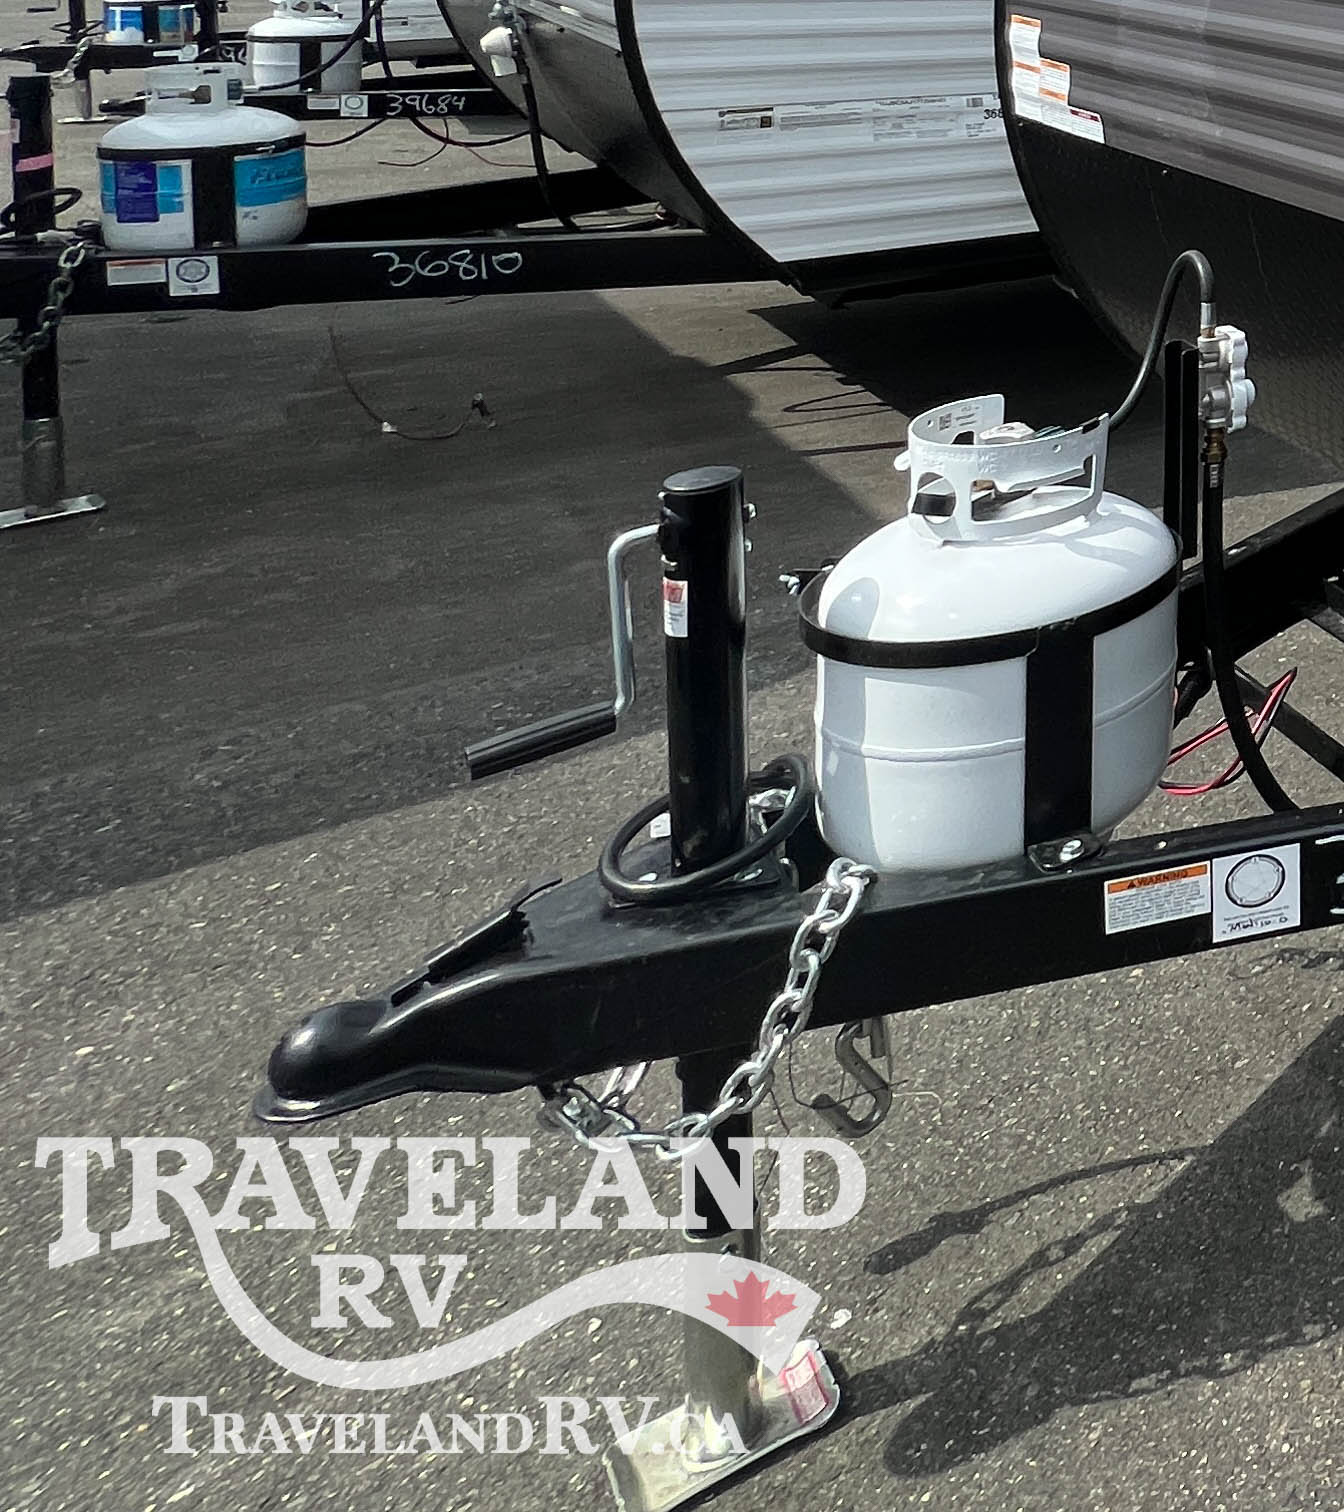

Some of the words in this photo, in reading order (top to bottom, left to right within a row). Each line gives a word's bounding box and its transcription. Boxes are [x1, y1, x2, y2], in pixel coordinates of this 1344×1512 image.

[386, 94, 465, 115] 39684
[372, 249, 523, 287] 36810
[1137, 869, 1188, 887] WARNING
